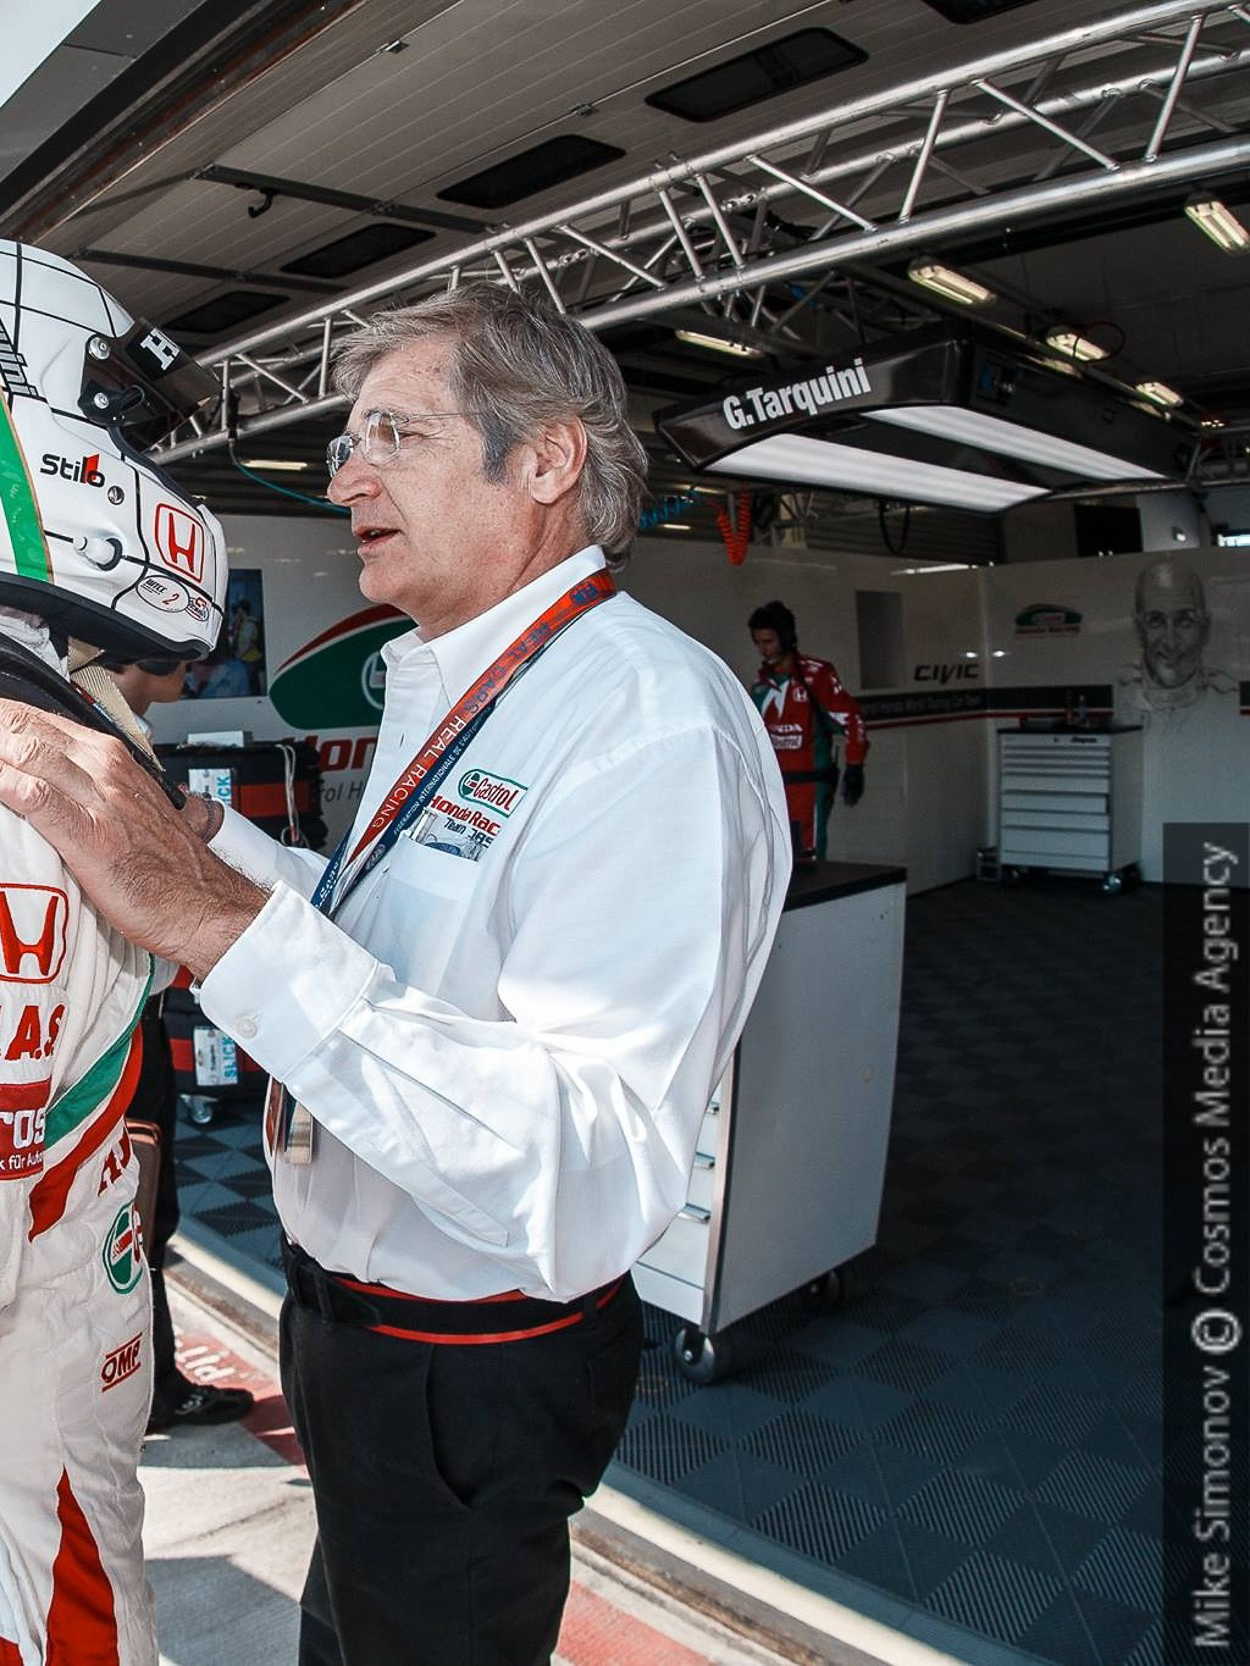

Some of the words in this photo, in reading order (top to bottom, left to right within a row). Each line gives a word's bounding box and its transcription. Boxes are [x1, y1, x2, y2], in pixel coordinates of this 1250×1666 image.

[723, 357, 872, 430] G.Tarquini
[40, 453, 106, 487] Stilo
[162, 592, 180, 605] 2
[914, 663, 980, 685] CIVIC
[424, 714, 467, 759] REAL
[371, 763, 428, 829] RACING
[473, 777, 520, 811] Castrol
[8, 1155, 26, 1170] für
[101, 1339, 141, 1385] OMP
